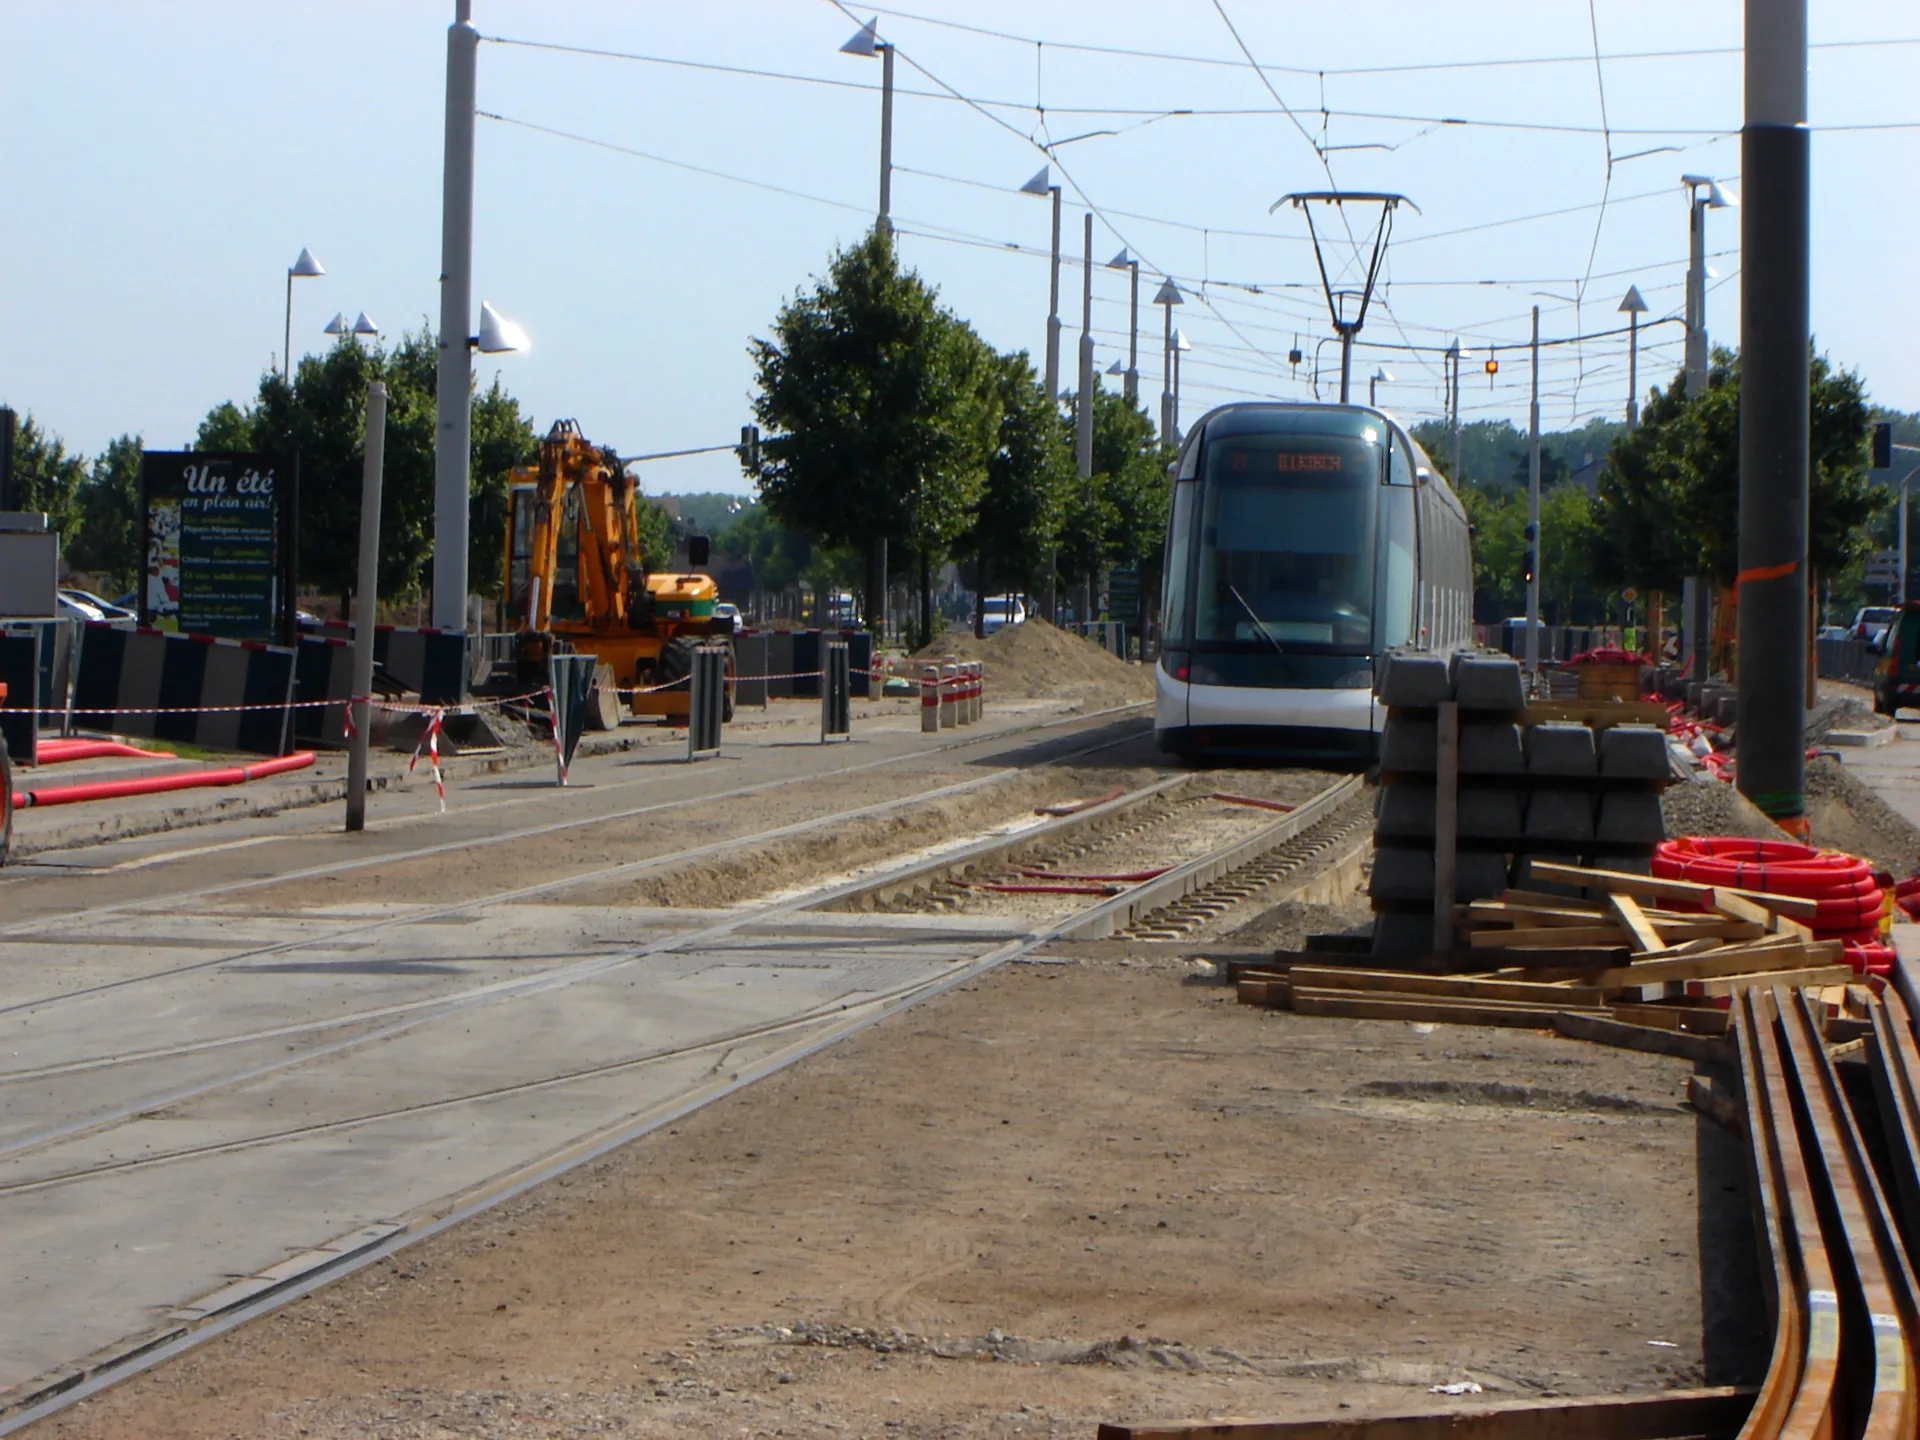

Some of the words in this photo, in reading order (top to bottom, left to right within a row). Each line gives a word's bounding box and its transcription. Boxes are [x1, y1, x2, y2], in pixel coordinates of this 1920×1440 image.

[183, 465, 227, 493] Un
[236, 468, 275, 493] été
[182, 496, 200, 508] en
[203, 493, 241, 513] plein
[244, 494, 273, 508] air!
